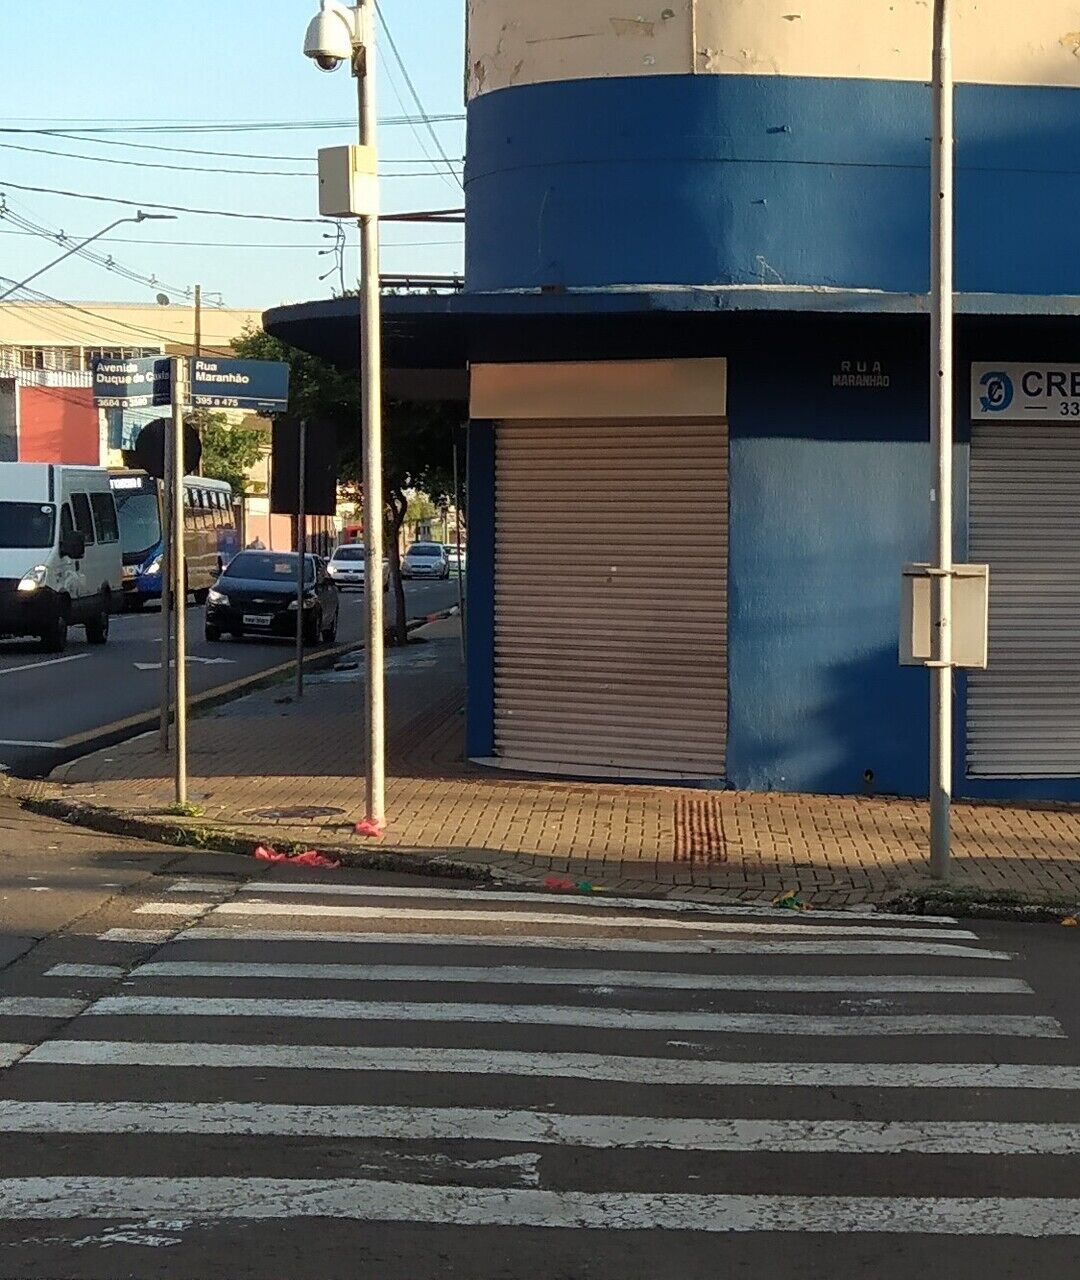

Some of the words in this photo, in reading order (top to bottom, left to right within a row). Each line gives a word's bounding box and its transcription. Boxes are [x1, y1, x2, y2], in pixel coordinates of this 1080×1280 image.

[97, 362, 138, 373] Avenida
[195, 361, 218, 371] Rua
[96, 373, 132, 385] Duque
[133, 373, 145, 383] de
[195, 371, 250, 384] Maranhão
[195, 396, 213, 405] 395
[214, 398, 221, 406] a
[221, 398, 239, 407] 475
